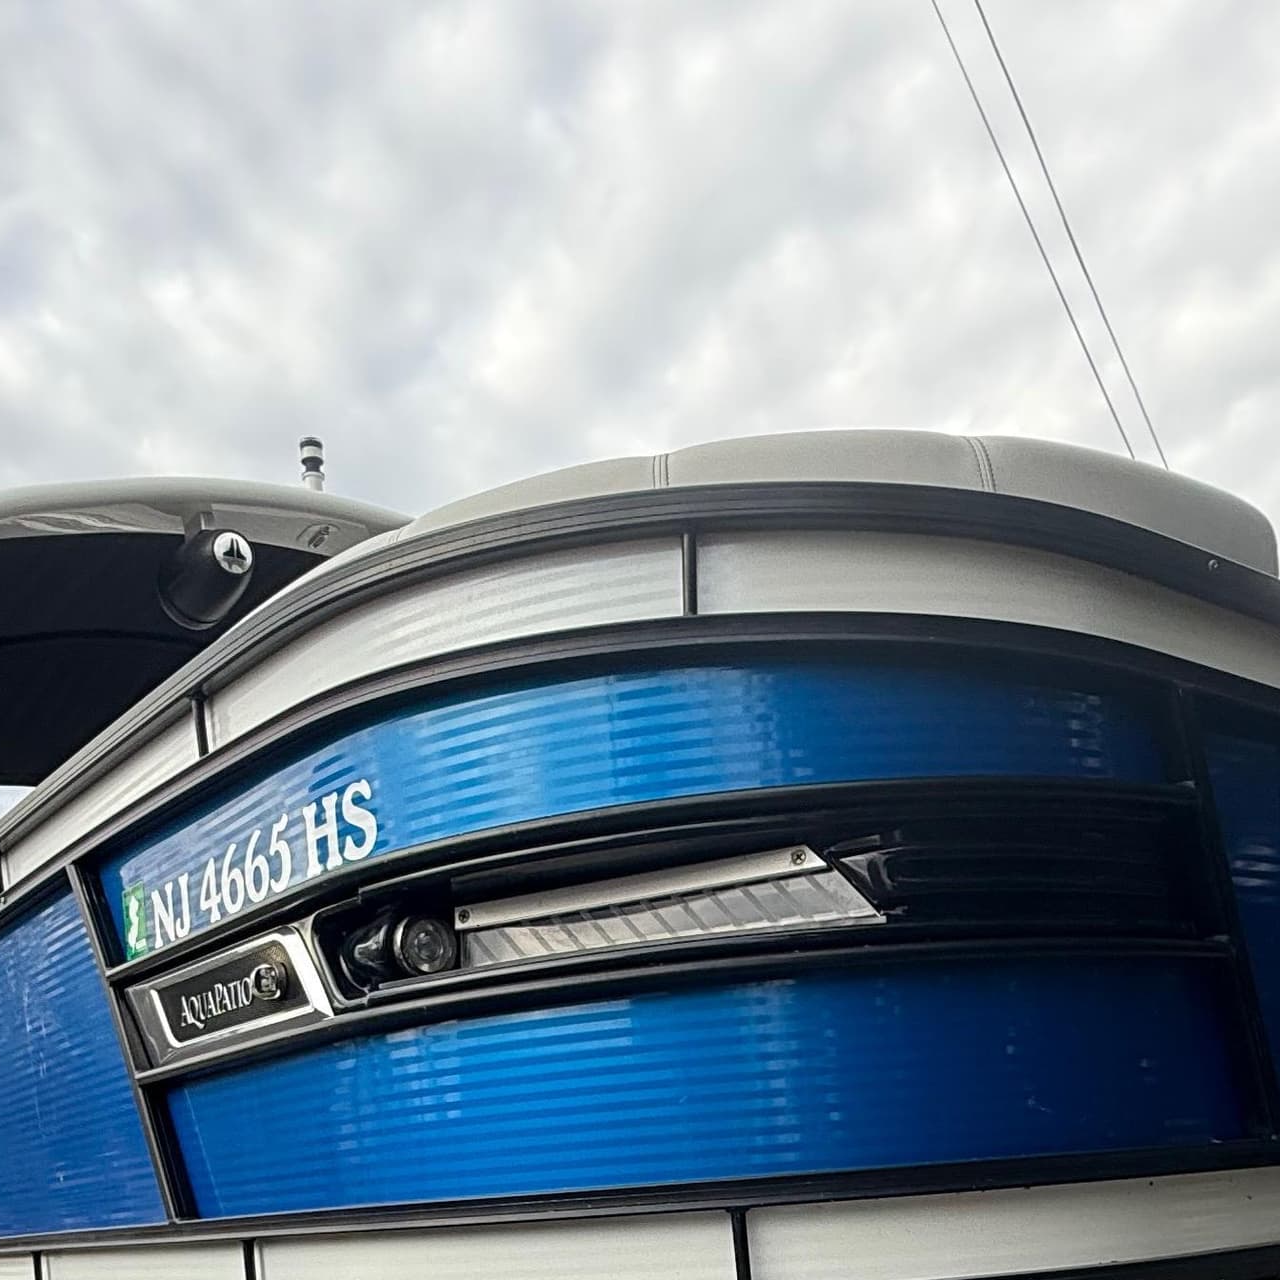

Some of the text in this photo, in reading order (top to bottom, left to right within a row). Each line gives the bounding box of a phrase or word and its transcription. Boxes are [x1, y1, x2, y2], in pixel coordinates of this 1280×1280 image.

[151, 779, 378, 949] NJ 4665 HS
[180, 976, 253, 1029] AQUAPATIO
